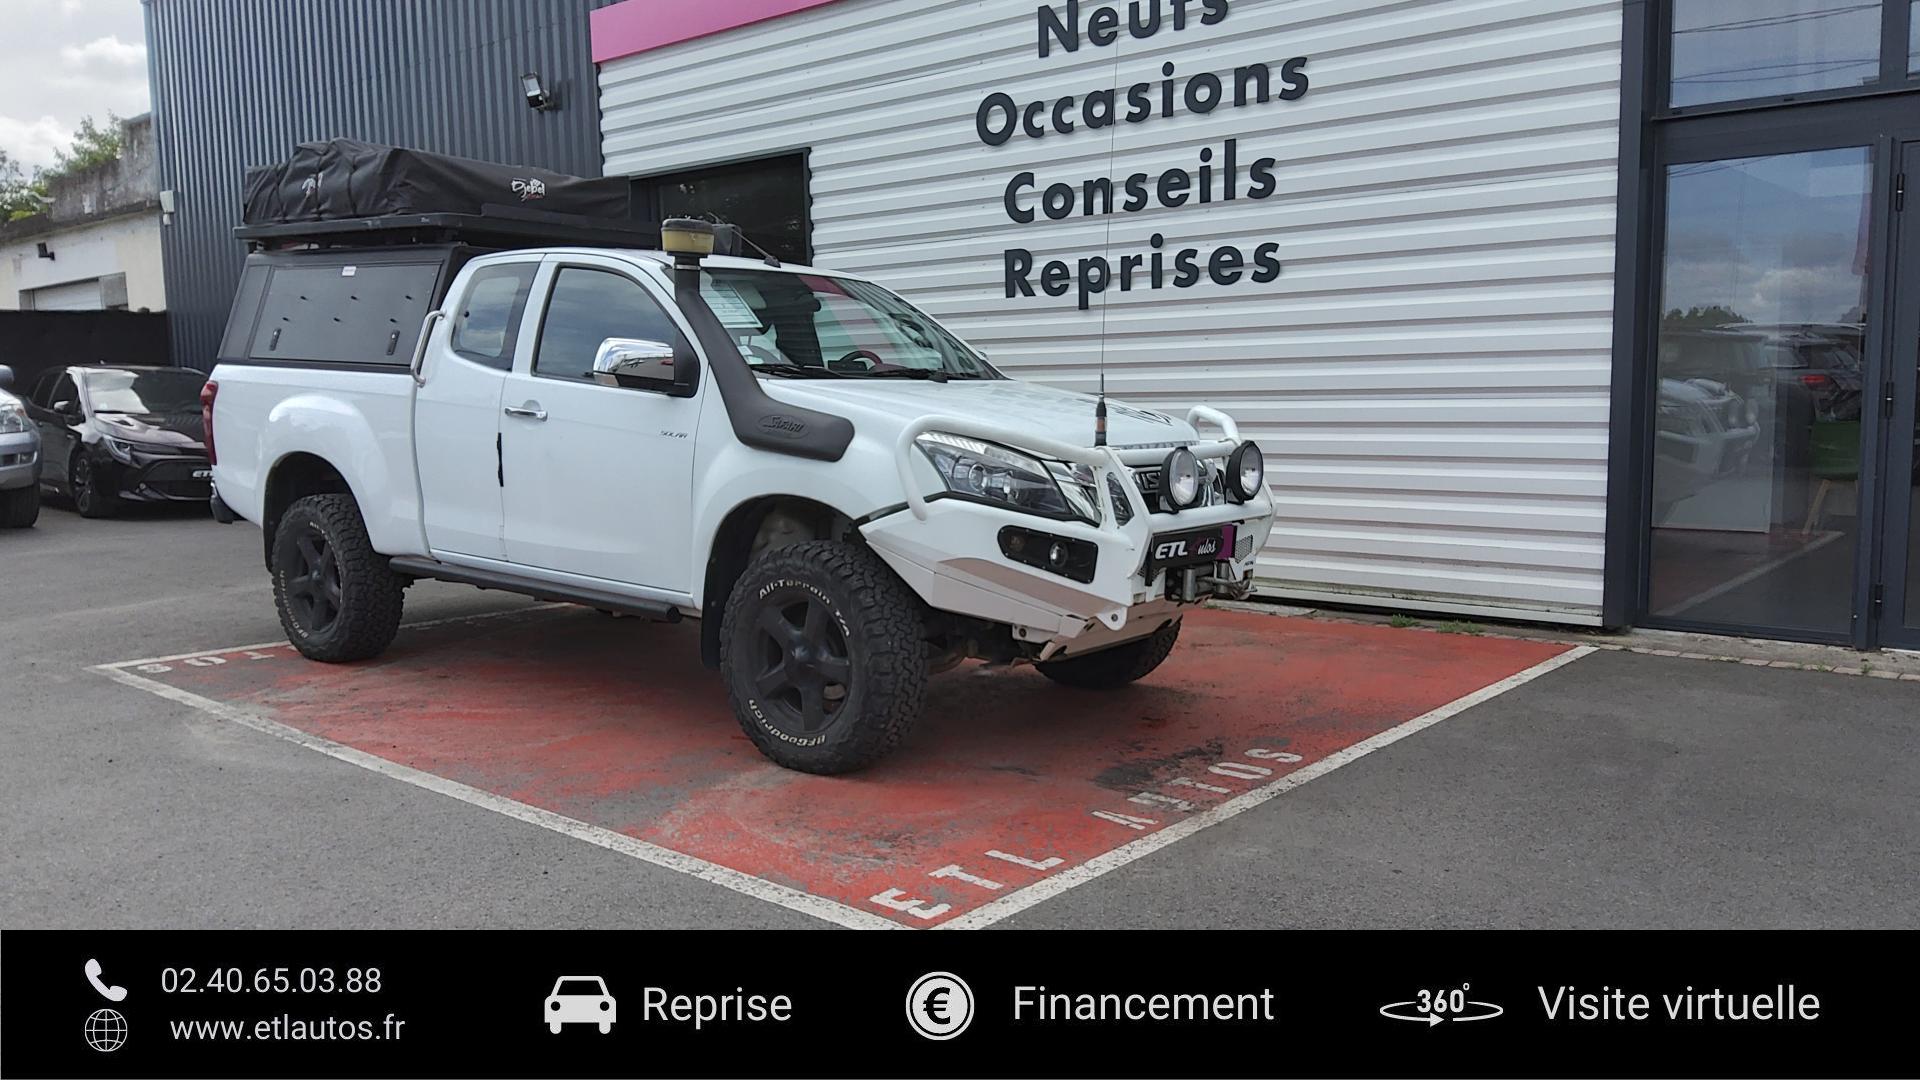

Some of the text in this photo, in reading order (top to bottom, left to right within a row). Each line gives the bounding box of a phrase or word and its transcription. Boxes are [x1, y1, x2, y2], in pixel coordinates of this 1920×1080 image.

[976, 56, 1309, 146] Occasions
[1004, 138, 1277, 224] Conseils
[1004, 233, 1281, 310] Reprises
[1155, 541, 1188, 560] ETL
[869, 850, 1065, 920] ETL
